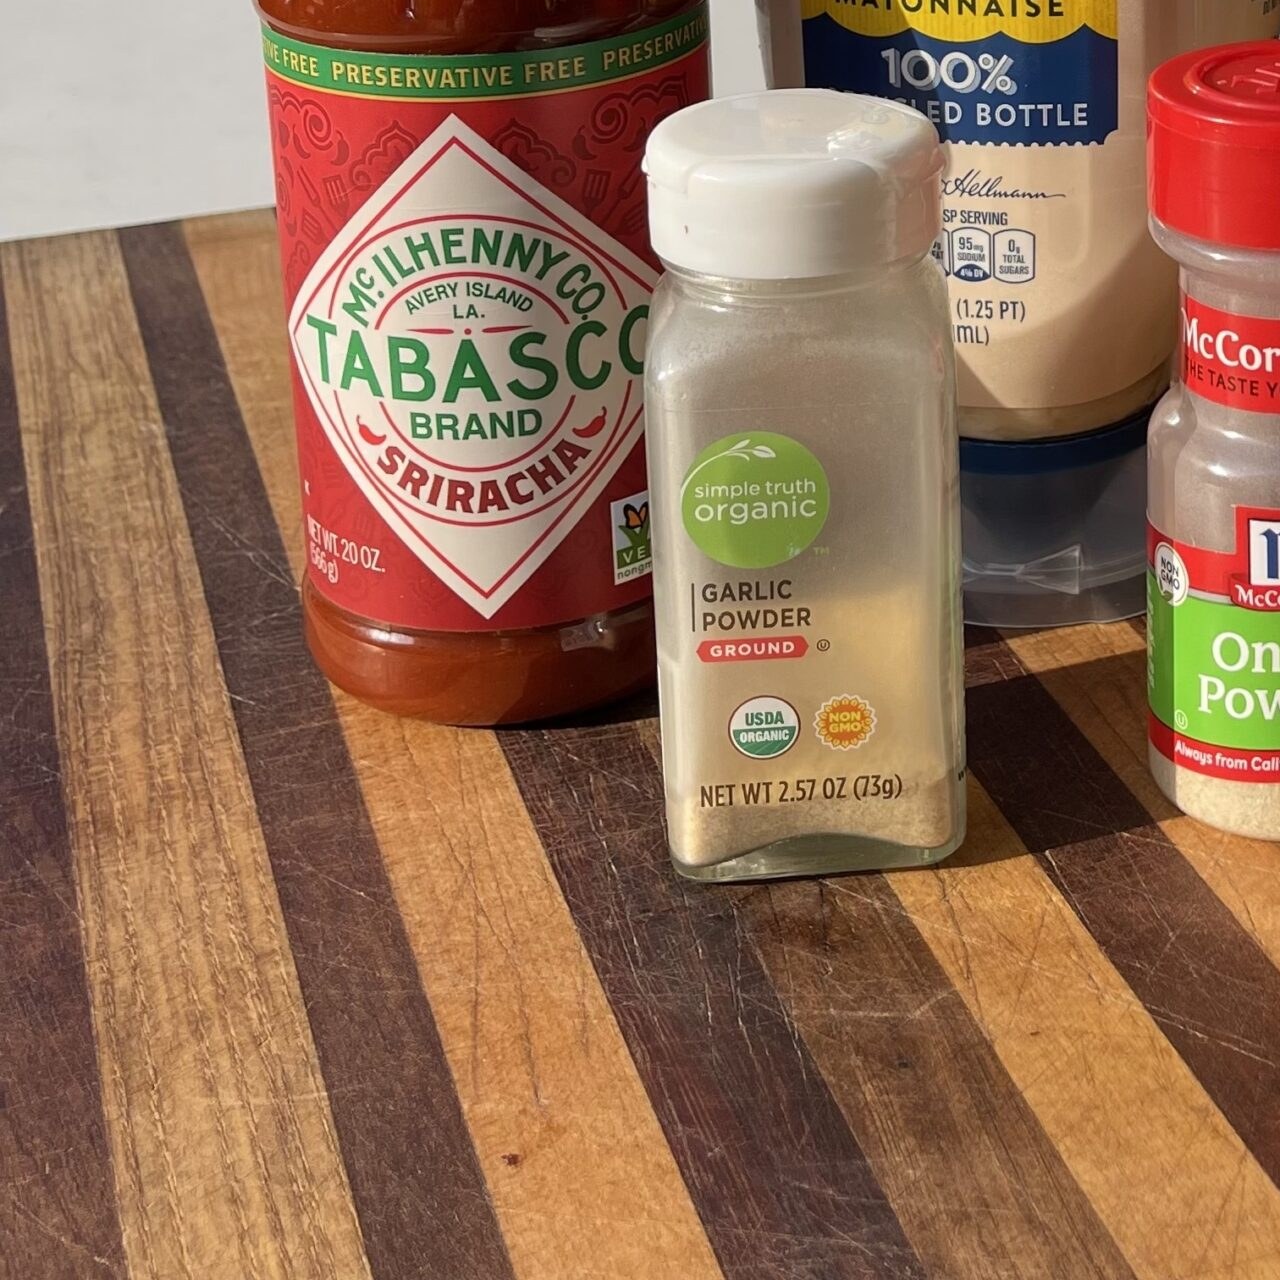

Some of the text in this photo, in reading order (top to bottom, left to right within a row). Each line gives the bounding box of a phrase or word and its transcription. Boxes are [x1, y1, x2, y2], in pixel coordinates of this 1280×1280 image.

[283, 48, 320, 77] FREE
[331, 60, 513, 89] PRESERVATIVE
[525, 56, 587, 84] FREE
[603, 16, 708, 71] PRESERVATI
[880, 47, 1018, 96] 100%
[976, 103, 1088, 127] BOTTLE
[943, 208, 1009, 226] SP SERVING
[957, 252, 986, 262] SODIUM
[1002, 255, 1025, 263] TOTAL
[999, 265, 1030, 275] SUGARS
[404, 281, 534, 314] AVERY ISLAND
[556, 263, 607, 321] CO.
[453, 304, 486, 319] LA.
[956, 298, 1026, 322] (1.25 PT)
[1208, 369, 1259, 397] TASTE
[410, 408, 543, 441] BRAND
[376, 438, 593, 514] SRIRACHA
[694, 478, 816, 499] simple truth
[694, 496, 817, 525] organic
[340, 538, 358, 565] 20
[360, 545, 386, 573] OZ.
[1161, 556, 1179, 577] NON
[1161, 569, 1180, 590] GMO
[702, 580, 792, 602] GARLIC
[702, 608, 812, 631] POWDER
[709, 641, 795, 657] GROUND
[744, 711, 785, 726] USDA
[828, 711, 861, 723] NON
[829, 723, 862, 733] GMO
[739, 729, 790, 743] ORGANIC
[1174, 740, 1213, 766] Always
[1215, 752, 1247, 770] from
[700, 773, 903, 808] NET WT 2.57 OZ (73g)
